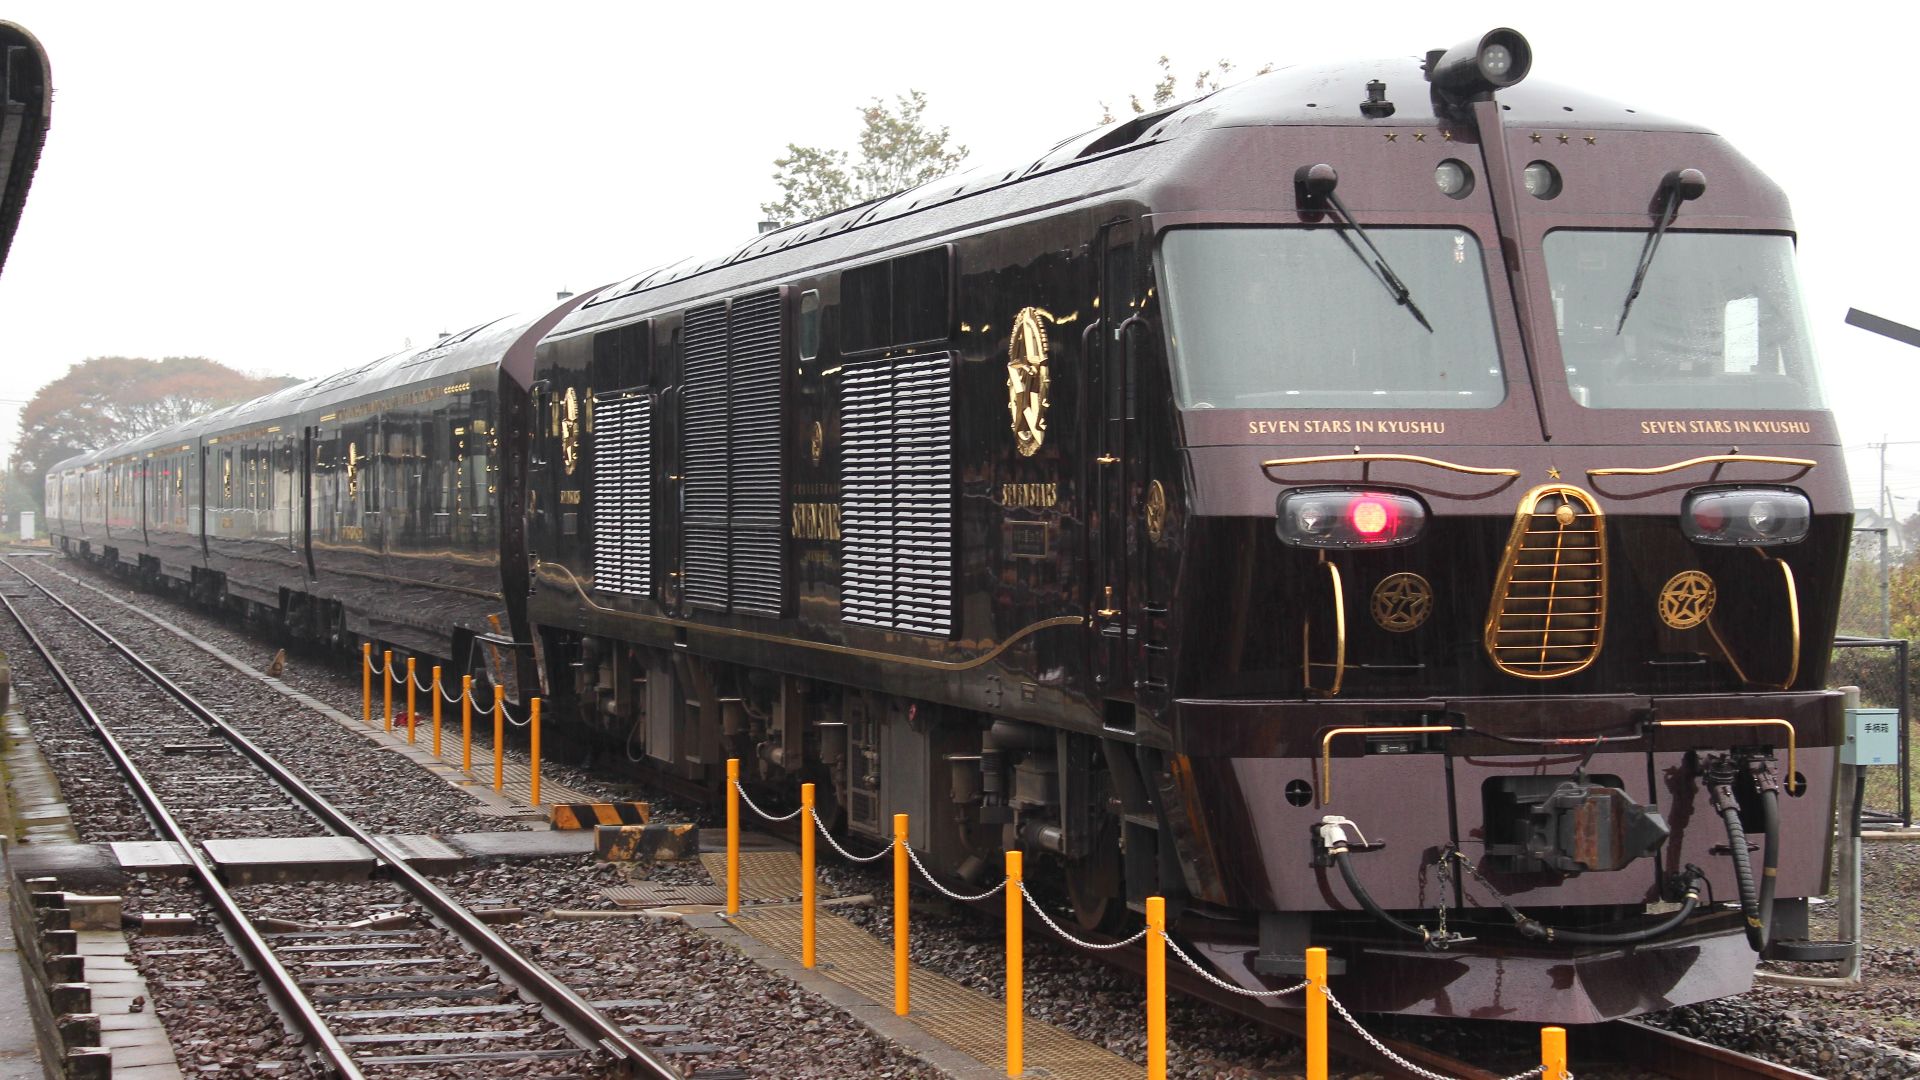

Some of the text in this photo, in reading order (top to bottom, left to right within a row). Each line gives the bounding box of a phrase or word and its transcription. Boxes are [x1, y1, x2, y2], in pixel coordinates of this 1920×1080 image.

[1248, 420, 1446, 434] SEVEN STARS IN KYUSHU
[1640, 420, 1811, 434] SEVEN STARS IN KYUSHU
